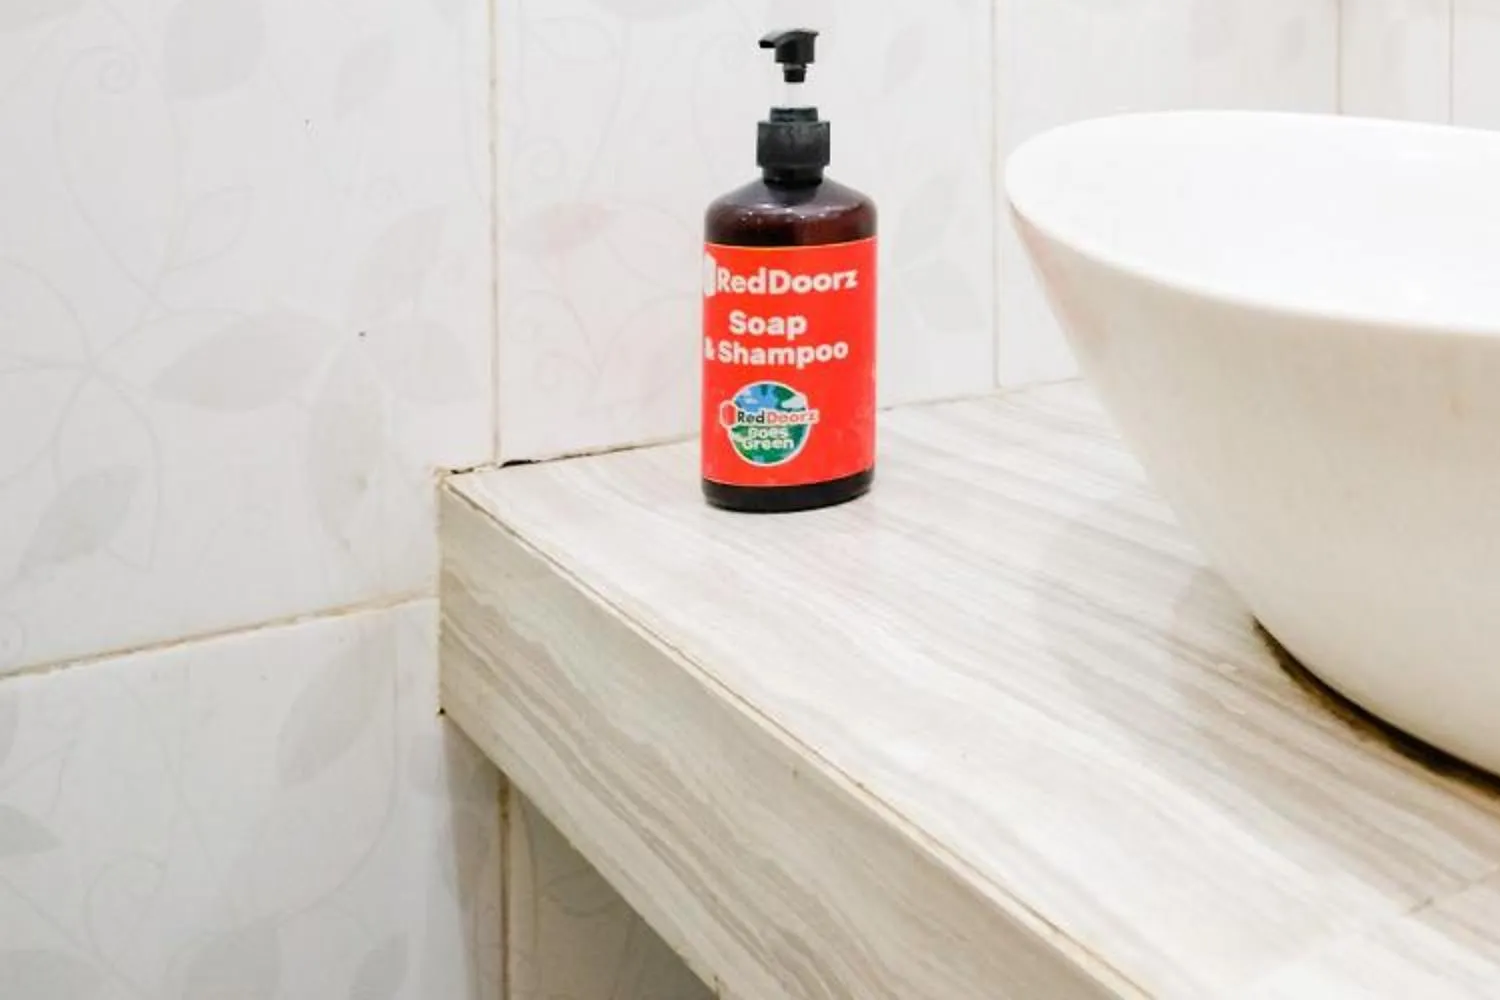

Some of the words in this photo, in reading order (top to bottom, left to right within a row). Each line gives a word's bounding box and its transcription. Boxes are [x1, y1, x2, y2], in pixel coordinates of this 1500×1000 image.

[717, 266, 858, 295] RedDoorz
[728, 309, 808, 341] Soap
[718, 341, 849, 370] Shampoo
[737, 409, 817, 425] RedDoorz
[743, 438, 795, 451] Green
